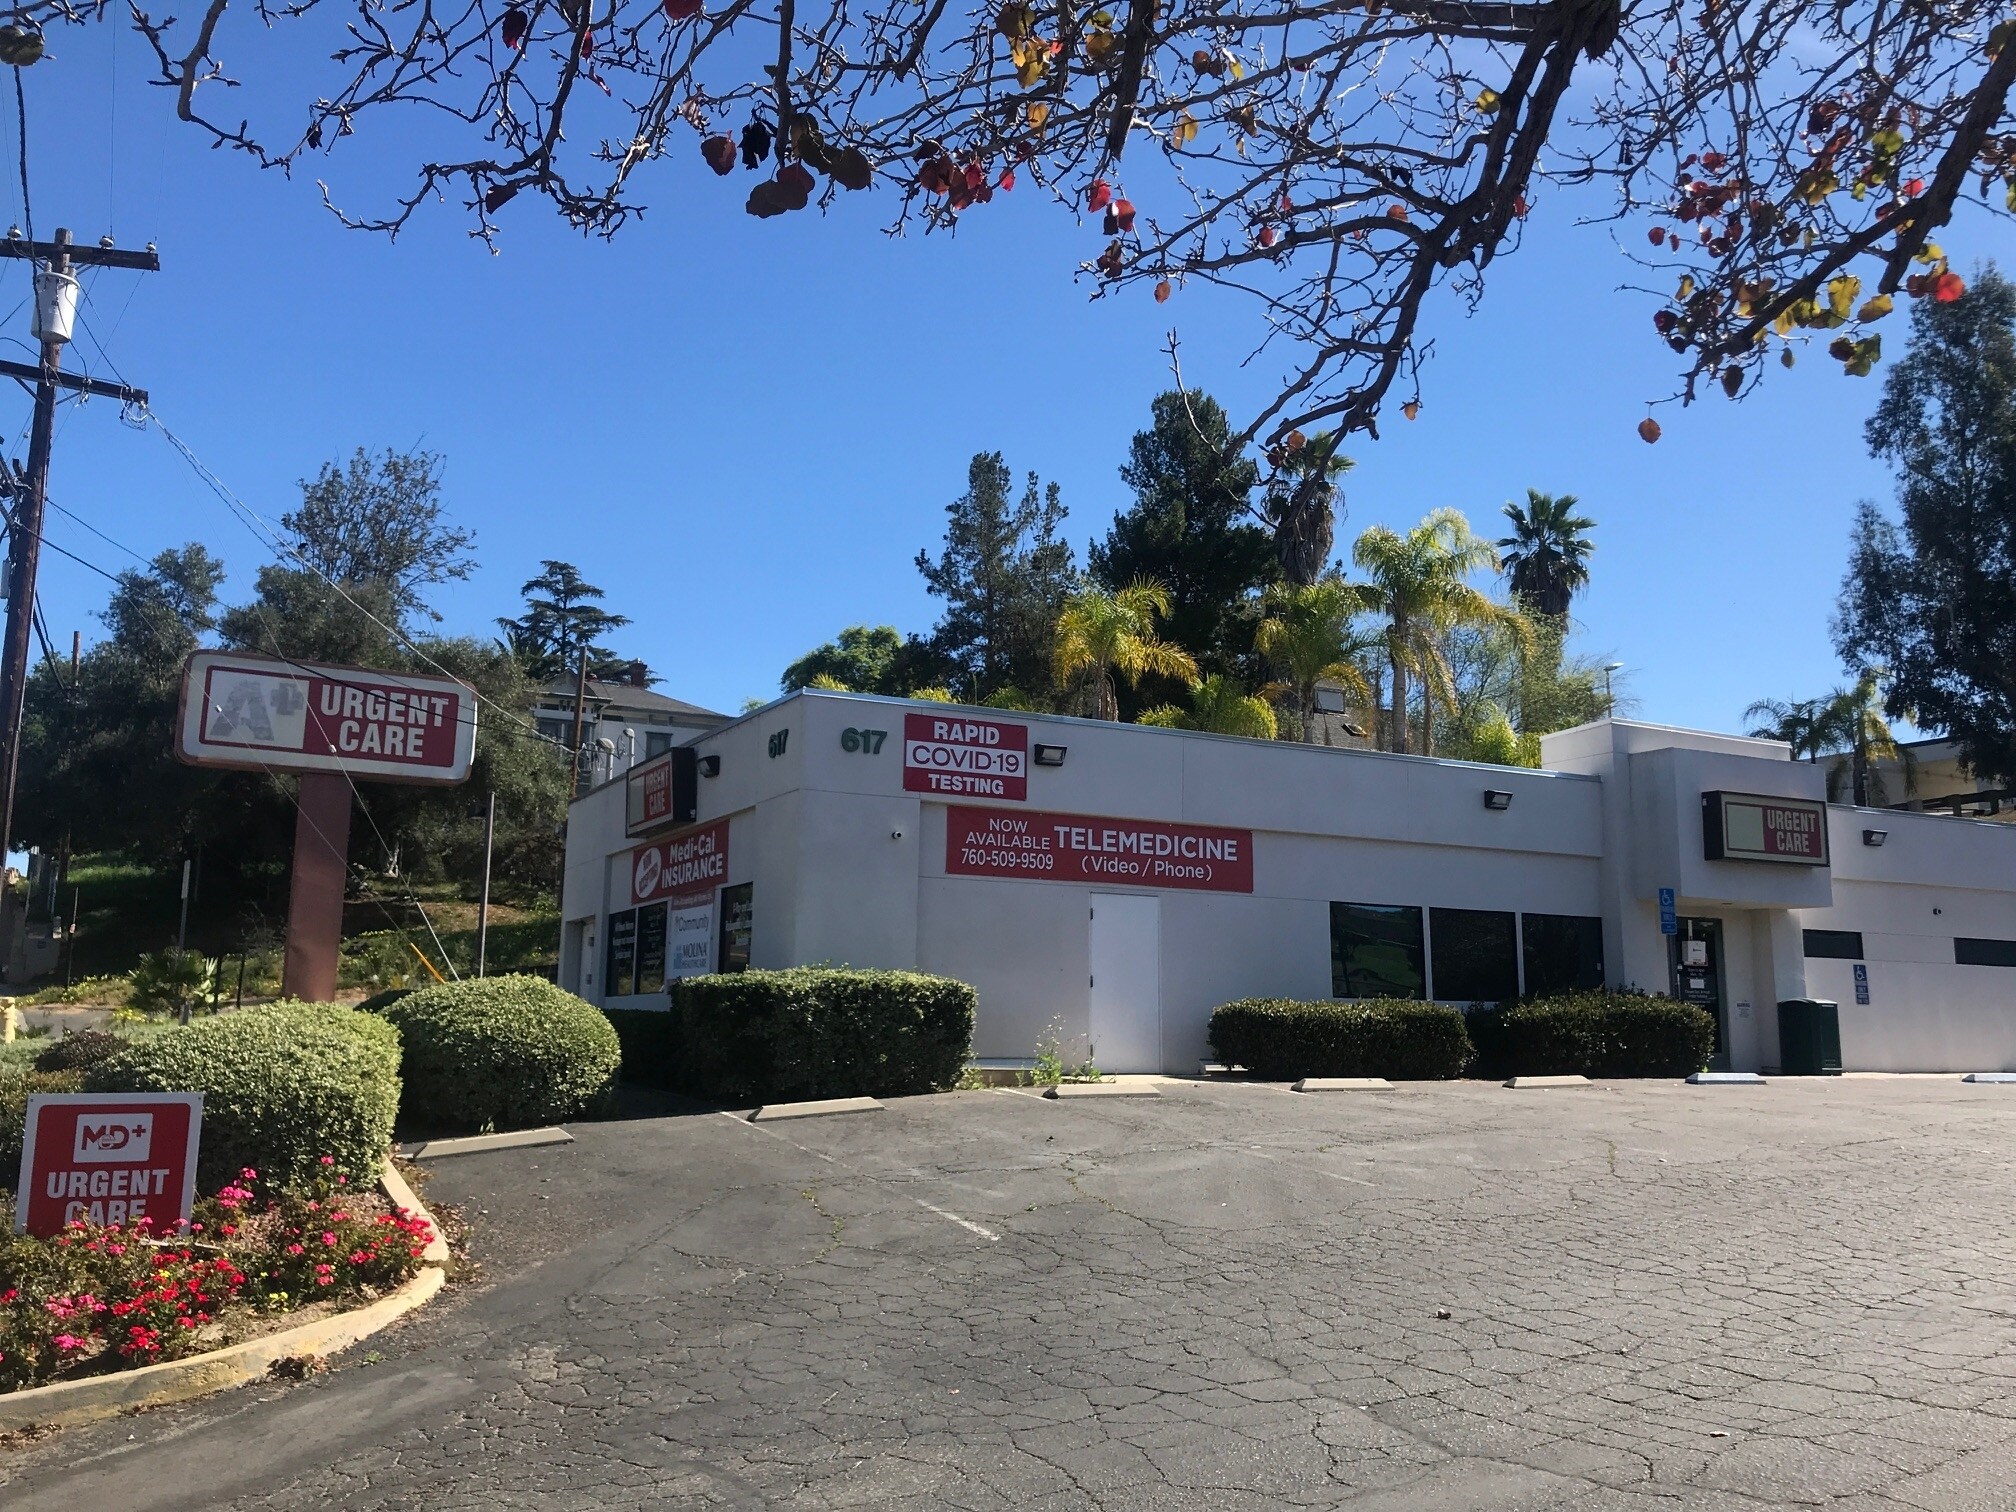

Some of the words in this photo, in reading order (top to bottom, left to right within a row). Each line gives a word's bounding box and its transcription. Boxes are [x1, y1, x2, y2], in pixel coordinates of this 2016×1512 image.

[320, 684, 449, 728] URGENT
[339, 720, 425, 759] CARE
[768, 729, 789, 759] 617
[841, 727, 888, 755] 617
[933, 721, 1000, 745] RAPID
[912, 745, 1019, 774] COVID-19
[645, 765, 670, 795] URGENT
[928, 773, 1004, 795] TESTING
[649, 790, 666, 816] CARE
[989, 818, 1028, 834] NOW
[1766, 809, 1816, 833] URGENT
[669, 830, 716, 864] Medi-Cal
[965, 831, 1051, 850] AVAILABLE
[1053, 825, 1238, 862] TELEMEDICINE
[1776, 831, 1810, 853] CARE
[661, 853, 723, 889] INSURANCE
[961, 848, 1054, 870] 760-509-9509
[683, 941, 708, 959] MOLINA
[46, 1169, 170, 1198] URGENT
